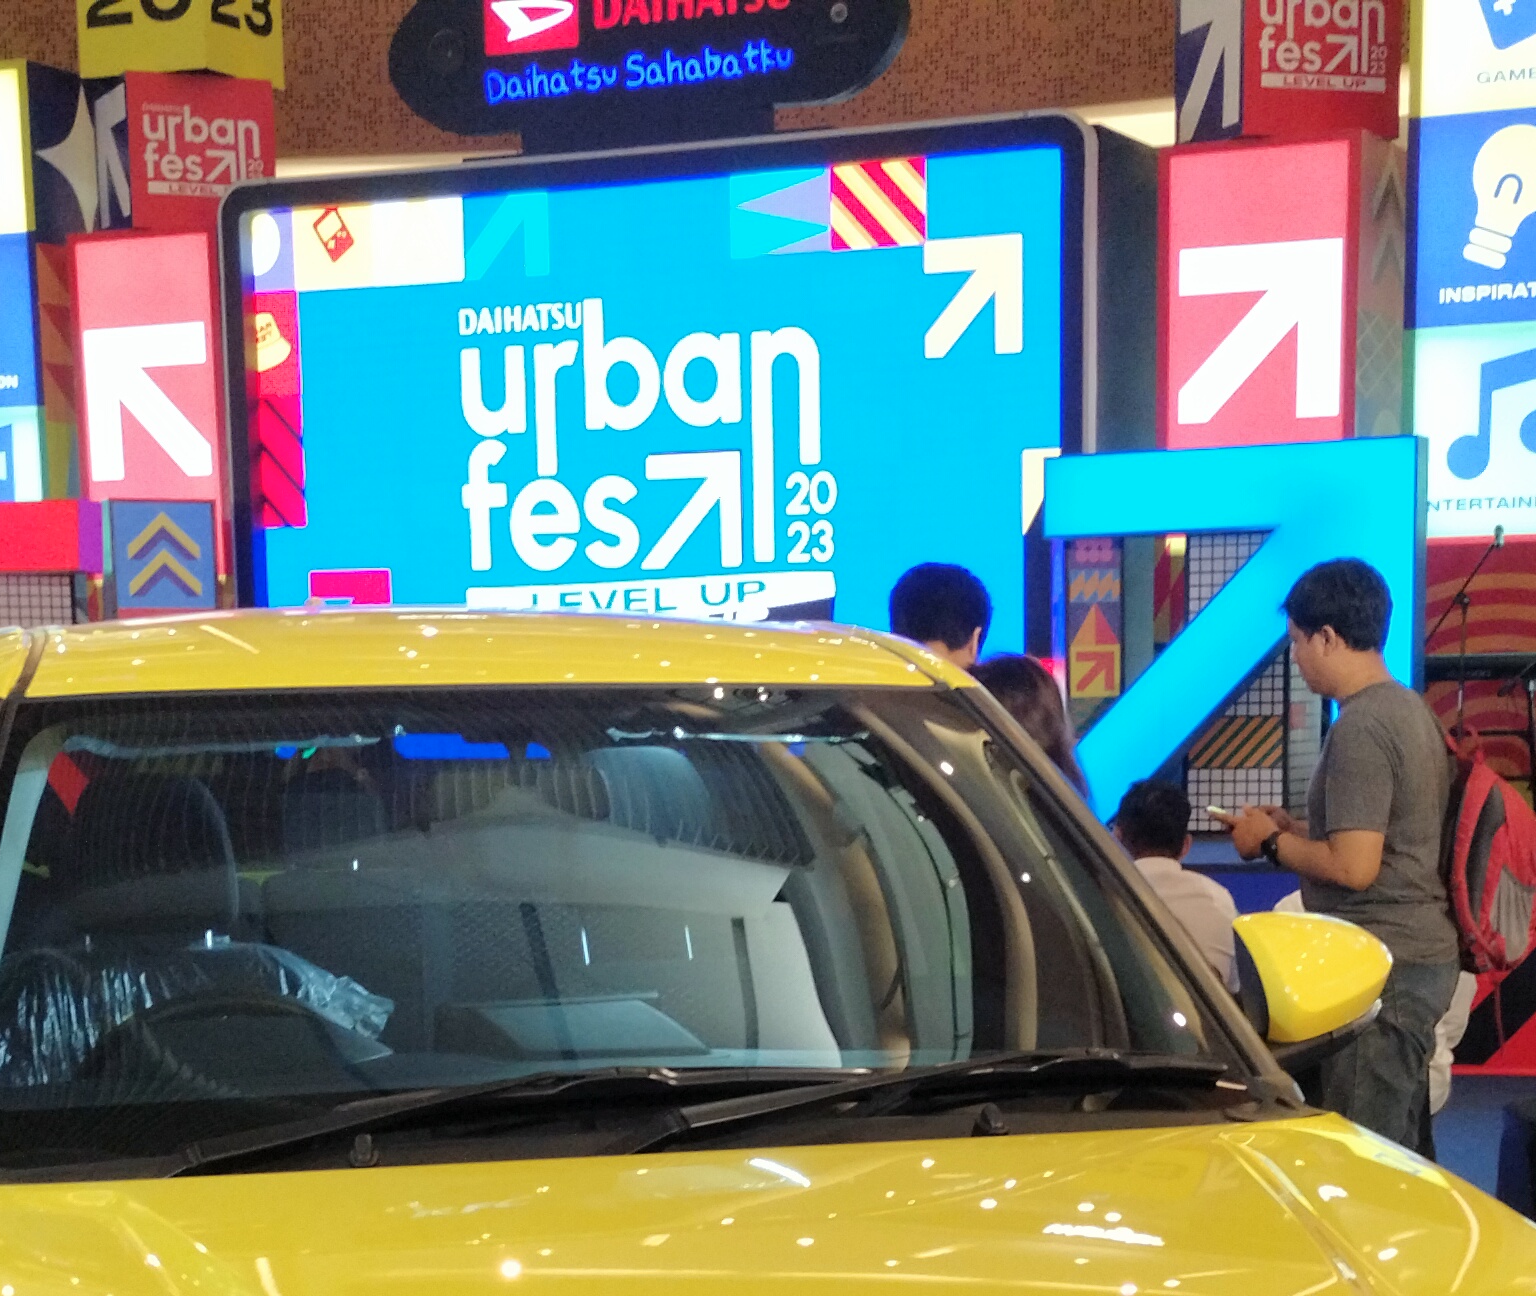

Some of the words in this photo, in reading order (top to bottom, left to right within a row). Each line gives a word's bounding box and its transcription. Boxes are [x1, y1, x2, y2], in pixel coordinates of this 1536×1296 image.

[485, 60, 617, 105] Daihatsu
[624, 39, 794, 89] Sahabatku
[1284, 75, 1336, 89] LEVEL
[1342, 78, 1366, 89] UP
[142, 104, 261, 180] urban
[459, 303, 582, 336] DAIHATSU
[460, 298, 821, 563] urban
[785, 471, 838, 517] 20
[786, 520, 835, 564] 23
[700, 580, 766, 607] UP
